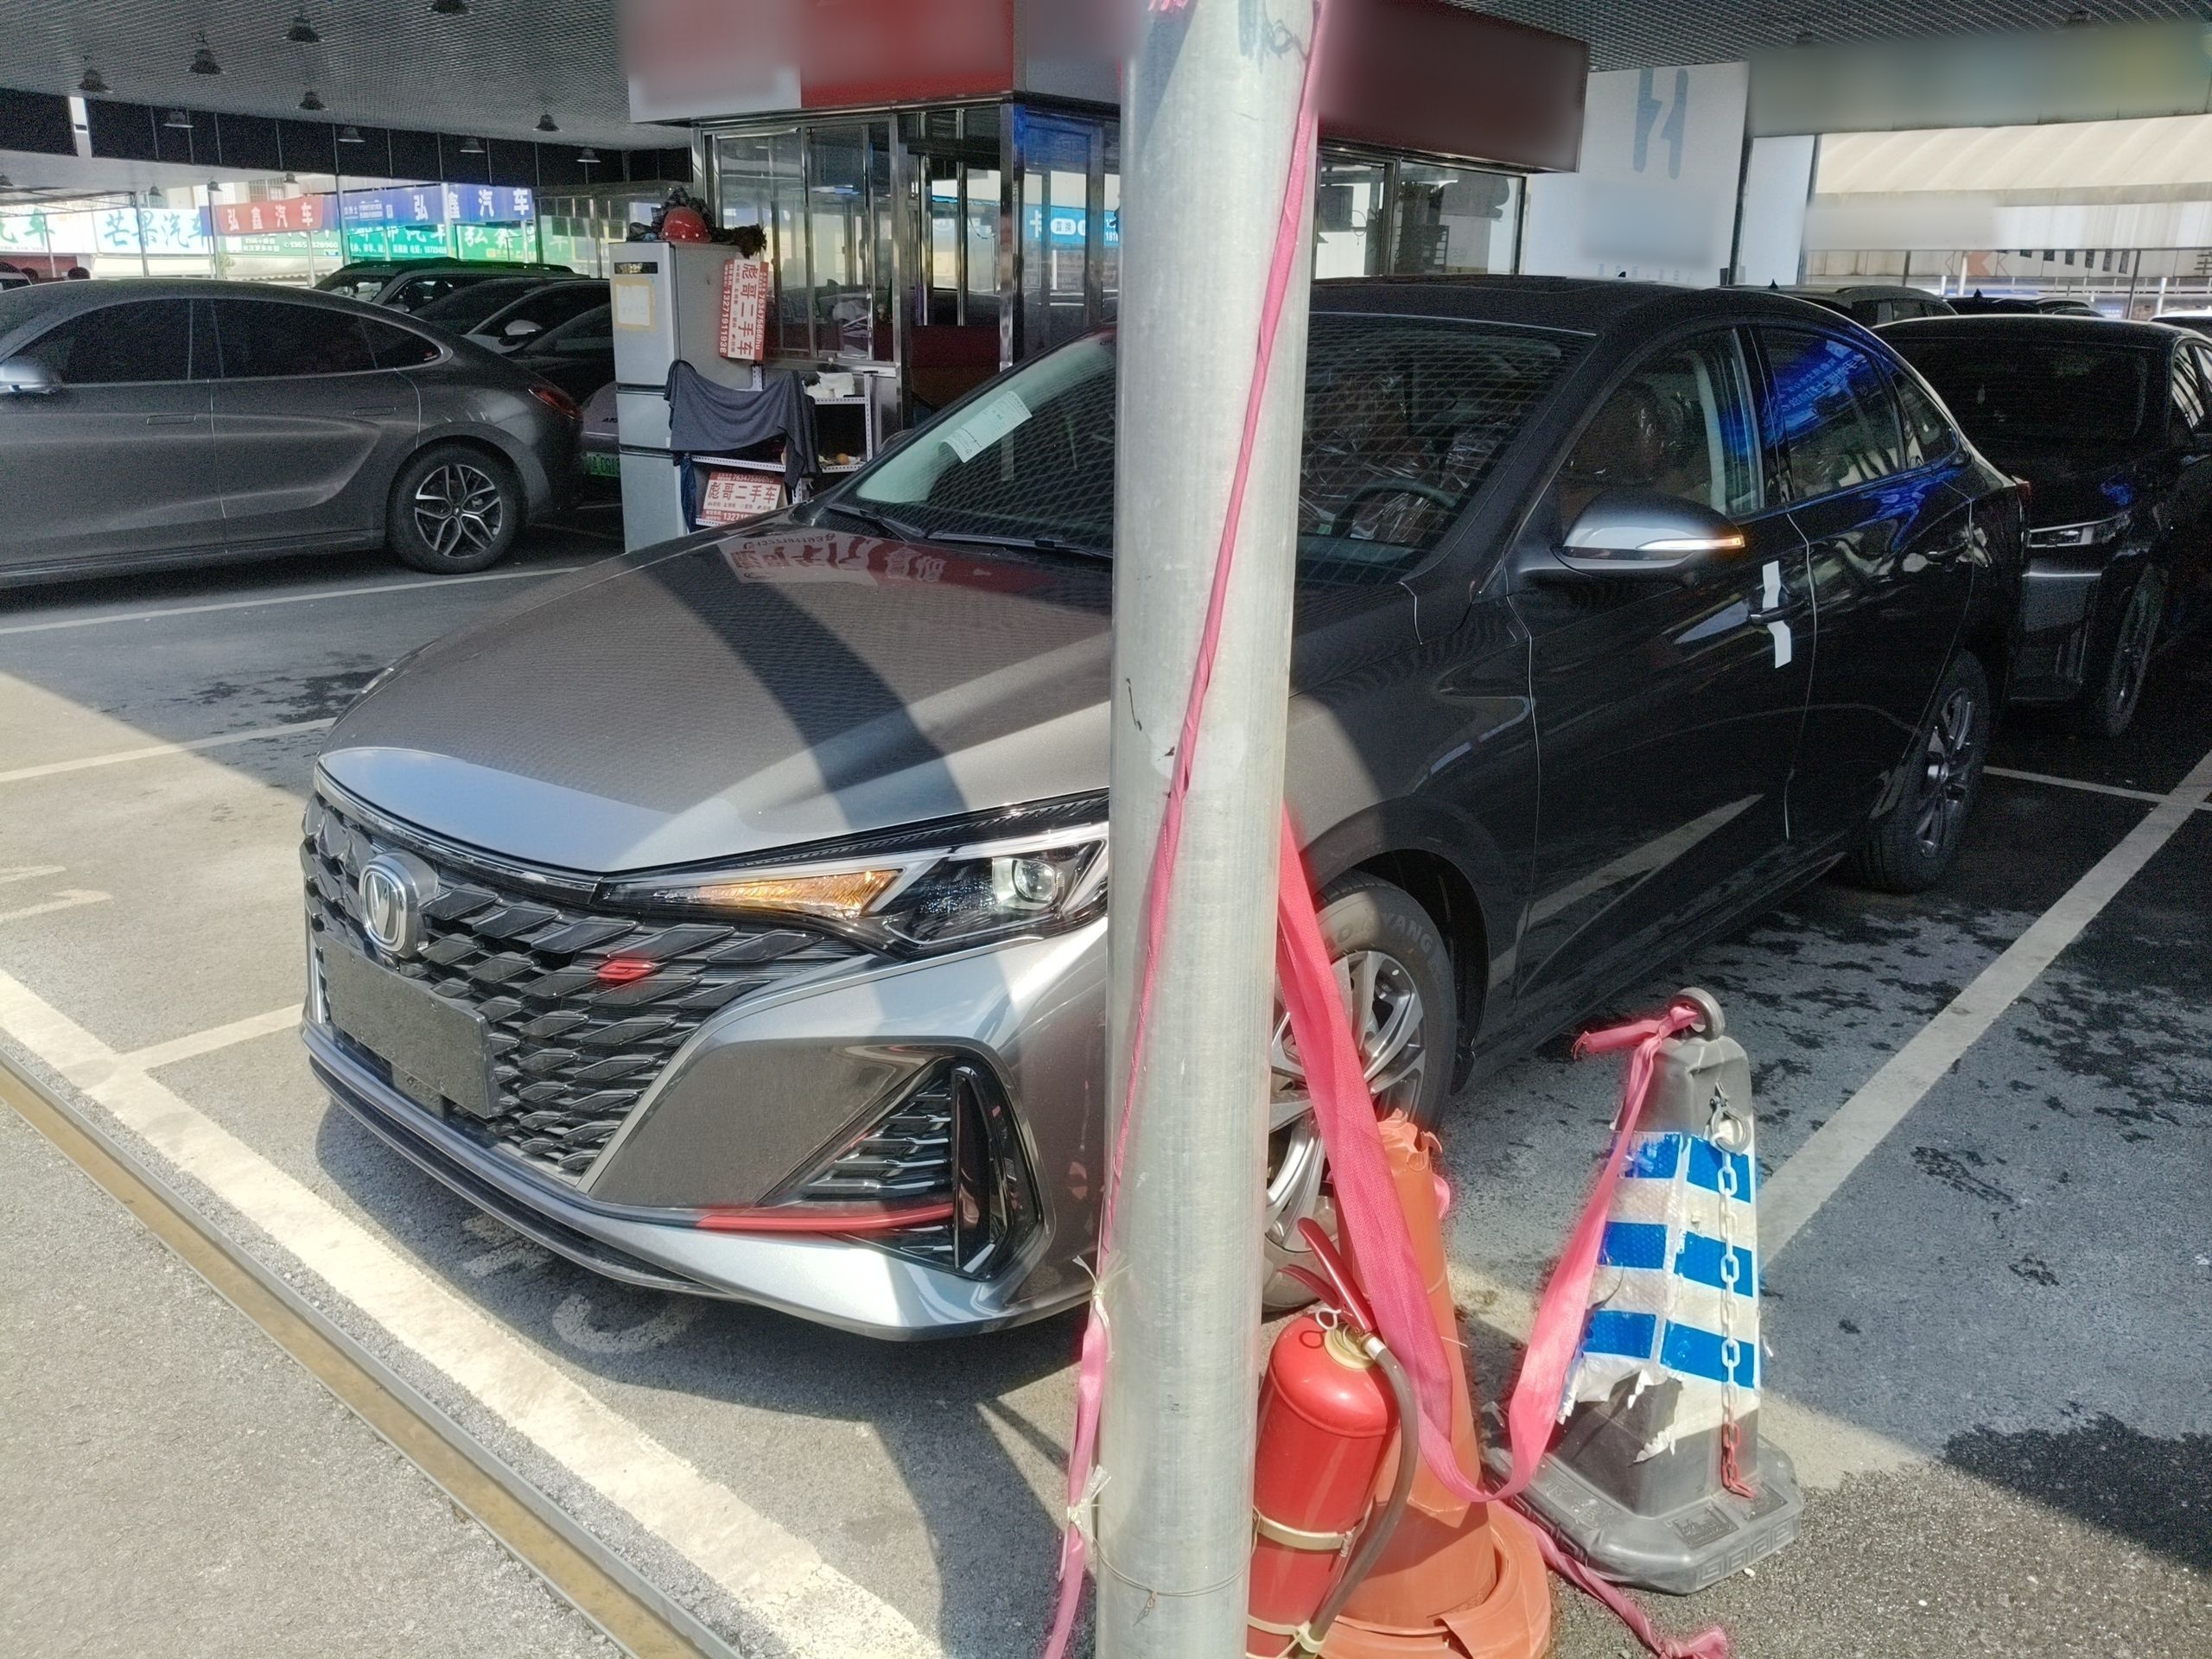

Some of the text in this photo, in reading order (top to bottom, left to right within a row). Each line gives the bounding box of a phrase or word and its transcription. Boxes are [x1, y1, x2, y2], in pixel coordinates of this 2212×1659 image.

[227, 202, 314, 232] 弘鑫汽车
[414, 188, 530, 221] 弘鑫汽车
[719, 289, 731, 353] 13271911938
[737, 263, 759, 356] 彪哥二手车
[708, 482, 778, 504] 彪哥二手车
